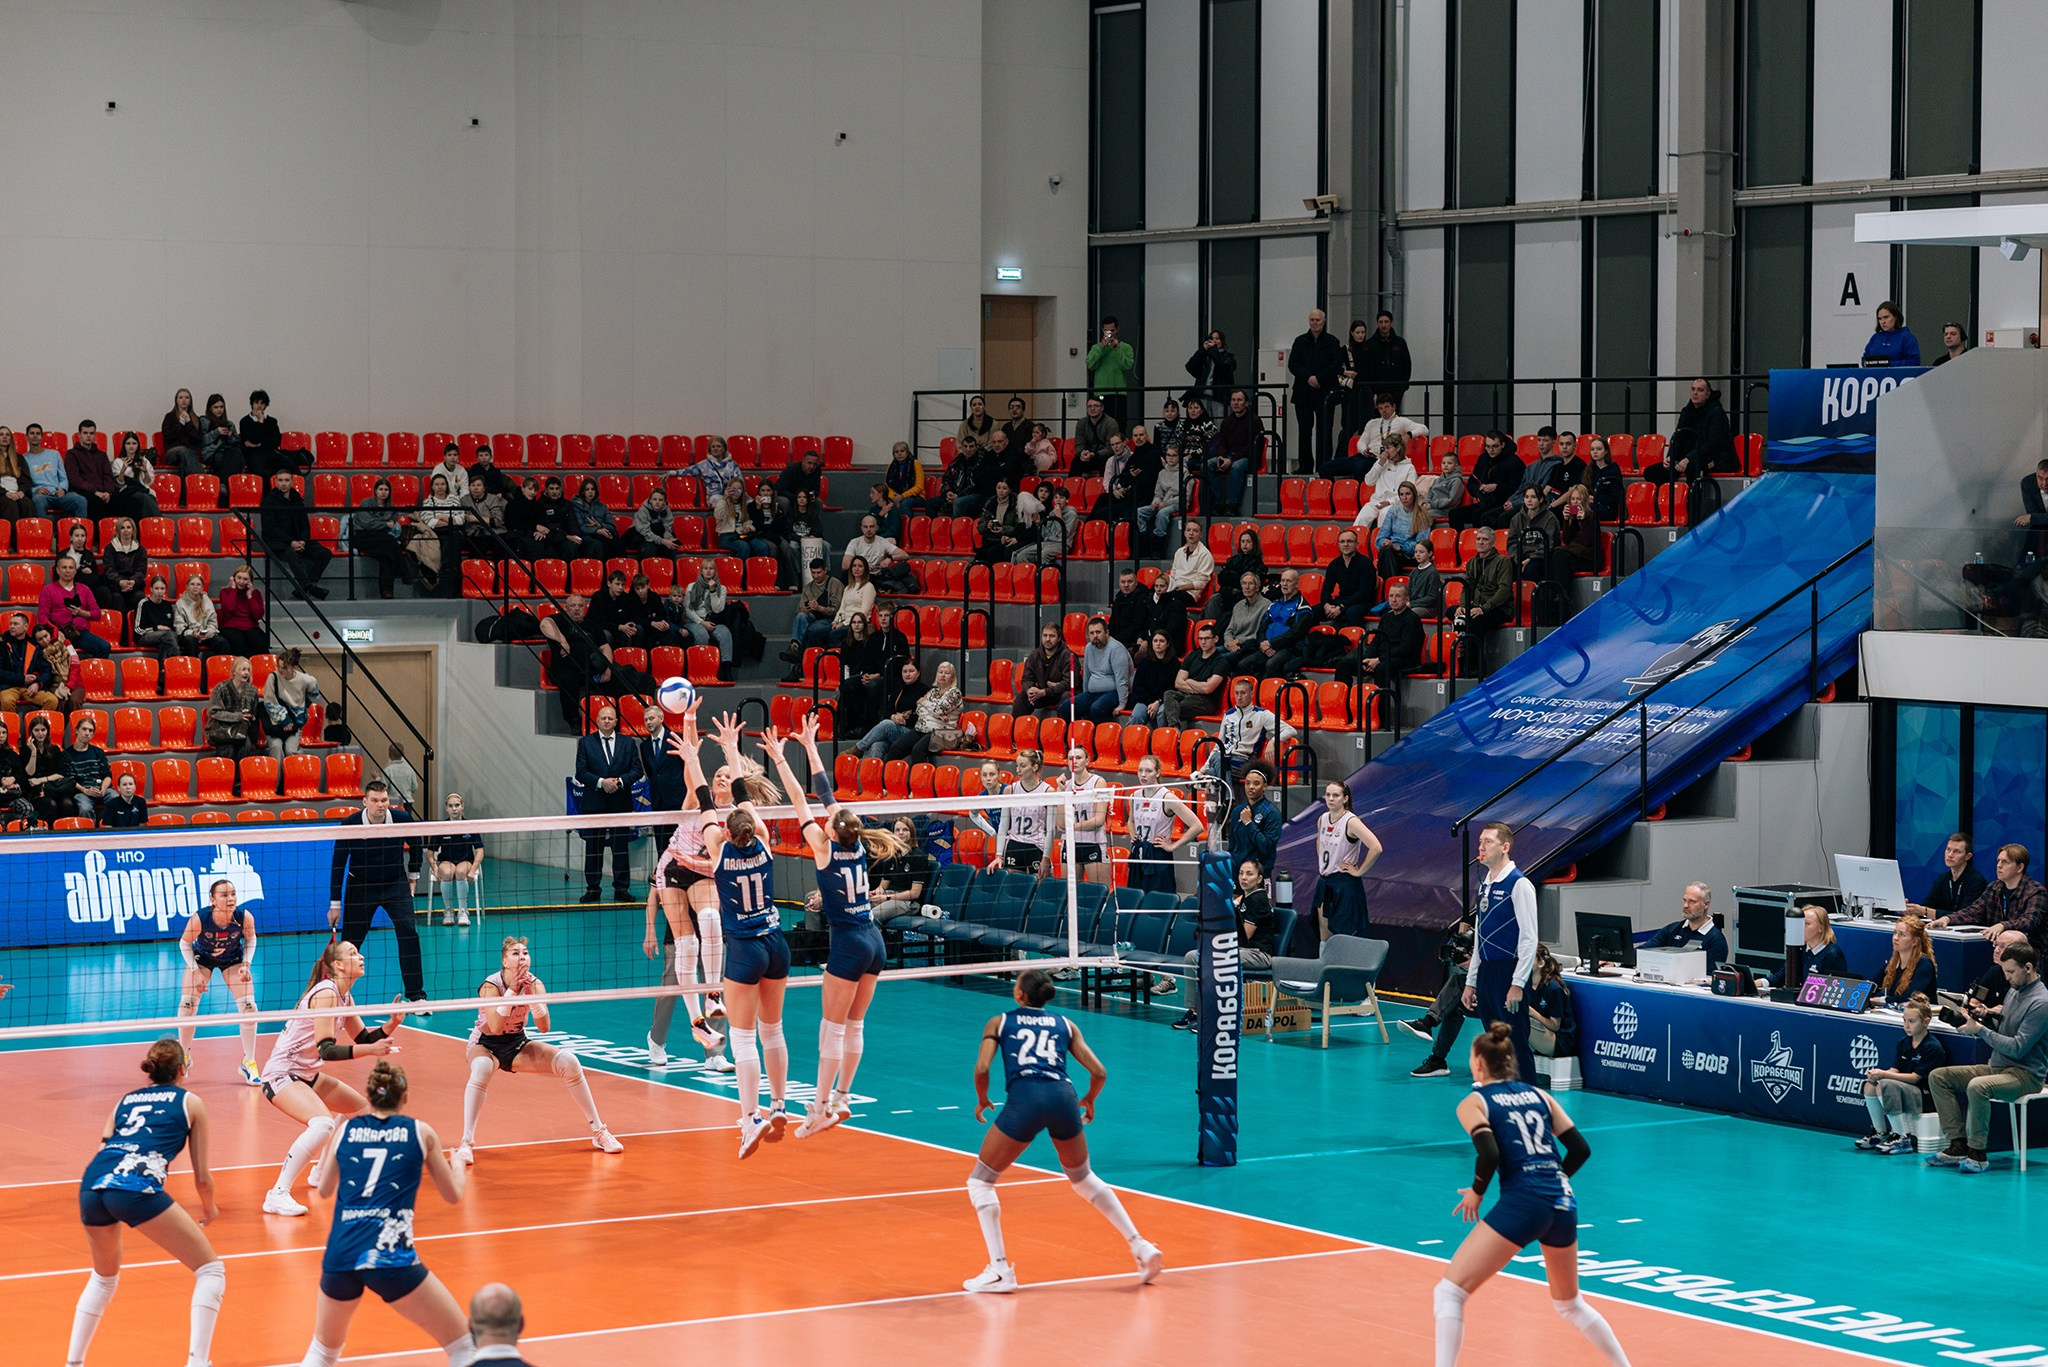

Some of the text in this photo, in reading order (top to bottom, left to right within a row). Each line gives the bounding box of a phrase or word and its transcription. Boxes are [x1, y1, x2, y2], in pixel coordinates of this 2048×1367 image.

[1840, 272, 1861, 306] А
[1489, 707, 1580, 724] МОРСКОЙ
[1512, 725, 1642, 746] УНИВЕРИТЕТ
[1015, 816, 1033, 835] 12
[116, 850, 145, 863] НПО
[1007, 856, 1016, 866] 12
[1321, 850, 1330, 870] 9
[736, 872, 765, 913] 11
[840, 864, 870, 904] 14
[1805, 984, 1819, 1002] 6
[1847, 990, 1860, 1008] 8
[1211, 931, 1239, 1080] КОРАБЕЛКА
[1016, 1015, 1056, 1027] МОРЕНО
[1246, 1015, 1297, 1030] DAPOL
[1016, 1028, 1058, 1067] 24
[1594, 1040, 1657, 1063] СУПЕРЛИГА
[1628, 1063, 1646, 1073] РОССИИ
[1694, 1053, 1729, 1075] ВФВ
[1753, 1064, 1800, 1085] КОРАБЕЛКА
[119, 1104, 153, 1136] 5
[347, 1127, 409, 1143] ЗАХАРОВА
[1508, 1109, 1553, 1155] 12
[361, 1147, 388, 1198] 7
